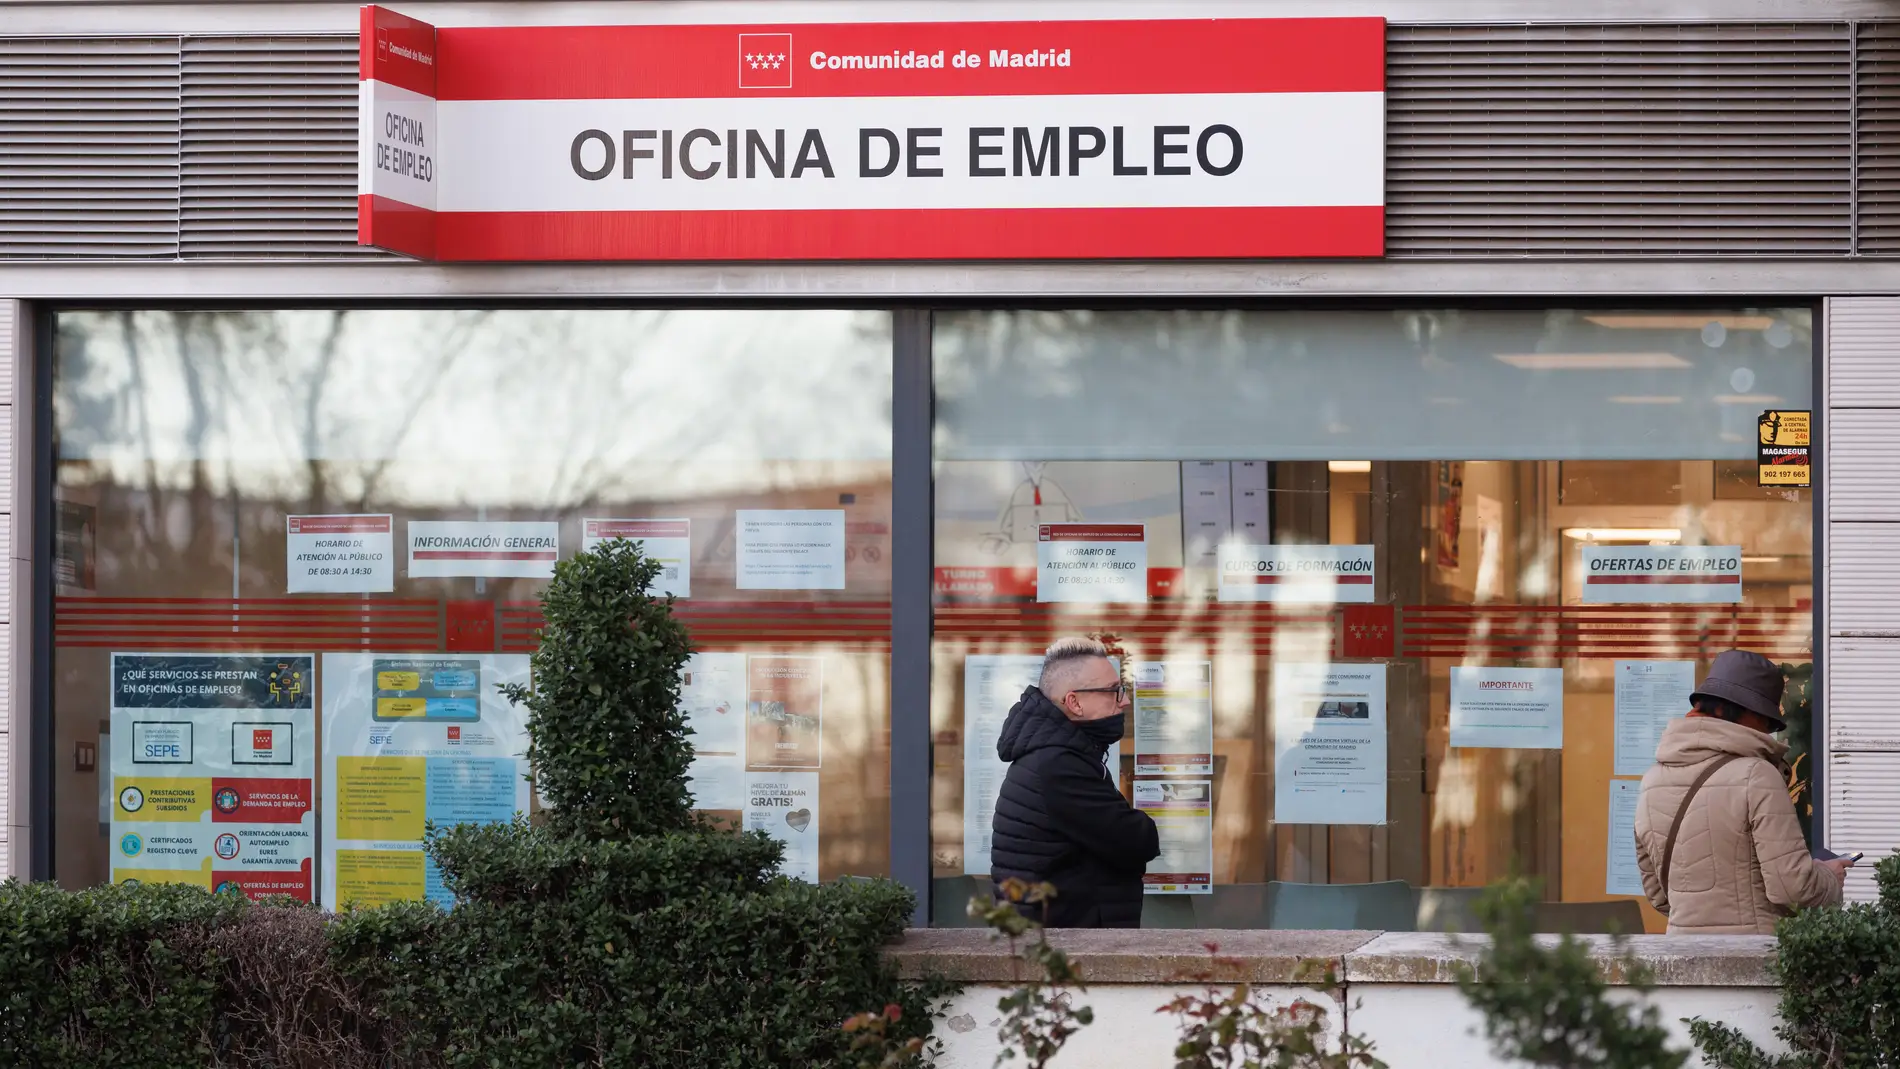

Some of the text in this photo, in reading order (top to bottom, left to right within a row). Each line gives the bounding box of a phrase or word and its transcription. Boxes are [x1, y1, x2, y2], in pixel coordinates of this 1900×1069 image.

[388, 42, 432, 66] Comunidad de Madrid
[810, 48, 1071, 69] Comunidad de Madrid
[386, 112, 424, 148] OFICINA
[570, 124, 1243, 180] OFICINA DE EMPLEO
[377, 143, 433, 183] DE EMPLEO
[315, 540, 351, 548] HORARIO
[414, 535, 557, 548] INFORMACIÓN GENERAL
[296, 551, 383, 561] ATENCIÓN AL PÚBLICO
[1066, 548, 1117, 556] HORARIO DE
[1046, 561, 1088, 570] ATENCIÓN
[1101, 561, 1136, 570] PÚBLICO
[1225, 558, 1373, 572] CURSOS DE FORMACIÓN
[1590, 558, 1737, 571] OFERTAS DE EMPLEO
[308, 568, 319, 576] DE
[319, 567, 341, 576] 08:30
[350, 567, 372, 575] 14:30
[1058, 576, 1069, 584] DE
[1070, 576, 1092, 584] 08:30
[122, 668, 258, 681] ¿QUÉ SERVICIOS SE PRESTAN
[123, 685, 242, 694] EN OFICINAS DE EMPLEO?
[1479, 681, 1534, 689] IMPORTANTE
[369, 736, 392, 745] SEPE
[145, 744, 180, 758] SEPE
[242, 800, 270, 808] DEMANDA
[750, 797, 793, 807] GRATIS!
[239, 829, 281, 837] ORIENTACIÓN
[147, 847, 176, 855] REGISTRO
[241, 857, 274, 865] GARANTÍA
[254, 890, 291, 899] FORMIÓN
